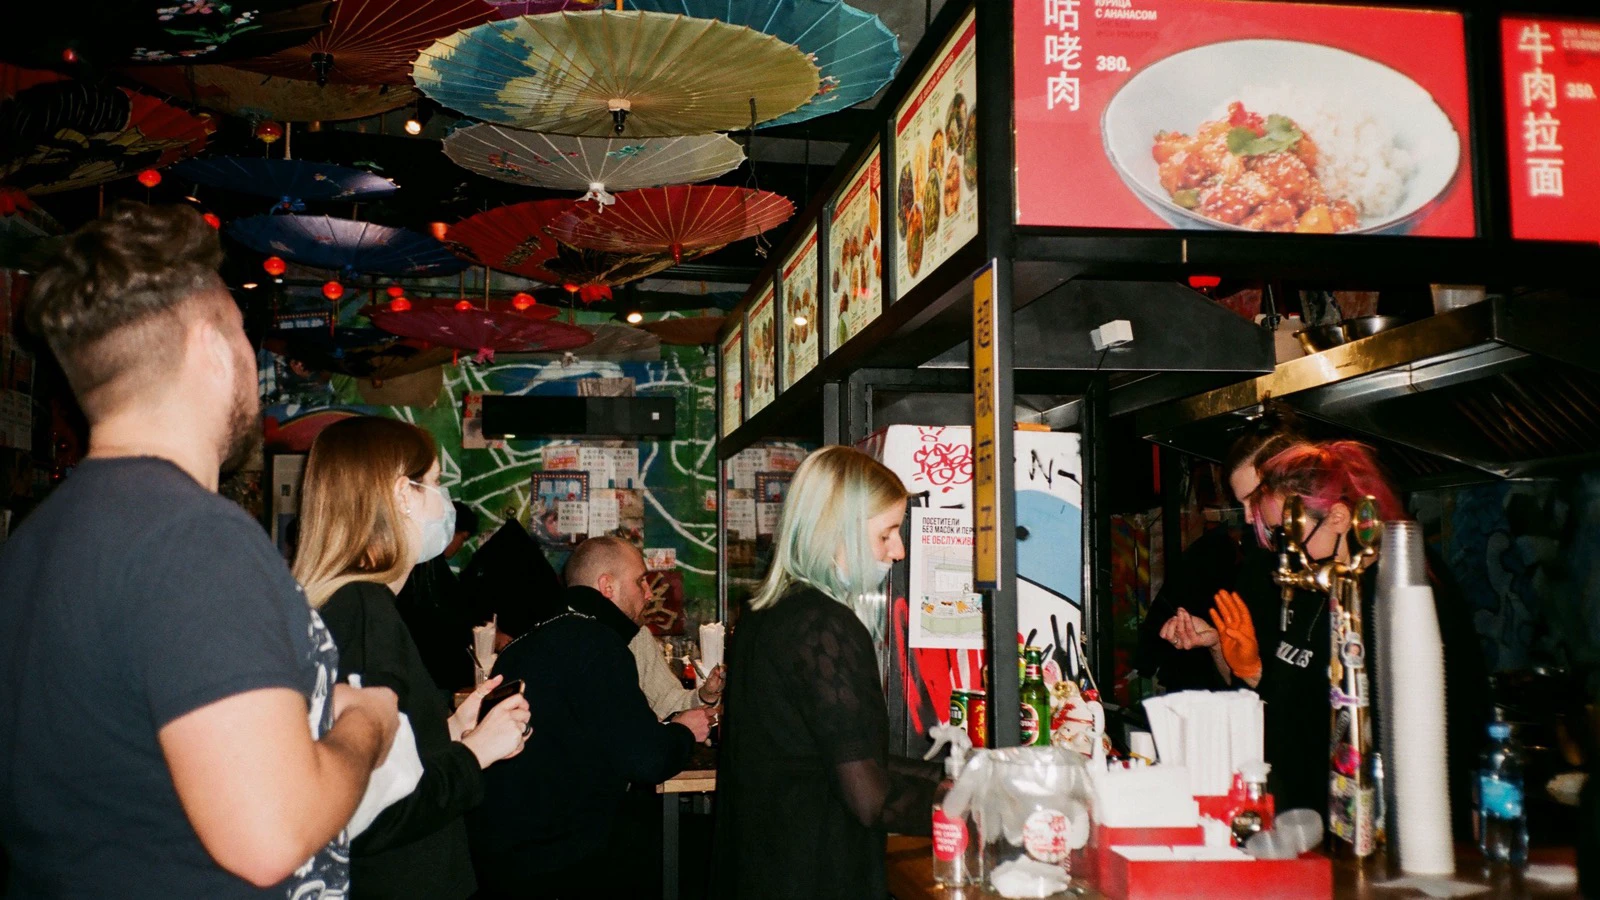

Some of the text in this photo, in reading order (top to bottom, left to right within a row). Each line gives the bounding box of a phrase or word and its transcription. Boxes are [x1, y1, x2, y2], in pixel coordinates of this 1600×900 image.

[1104, 9, 1157, 20] АНАНАСОМ
[1096, 55, 1131, 72] 380.
[1518, 23, 1564, 197] 牛肉拉面
[922, 517, 960, 526] ПОСЕТИТЕЛИ
[934, 526, 955, 534] МАСОК
[921, 535, 931, 545] НЕ
